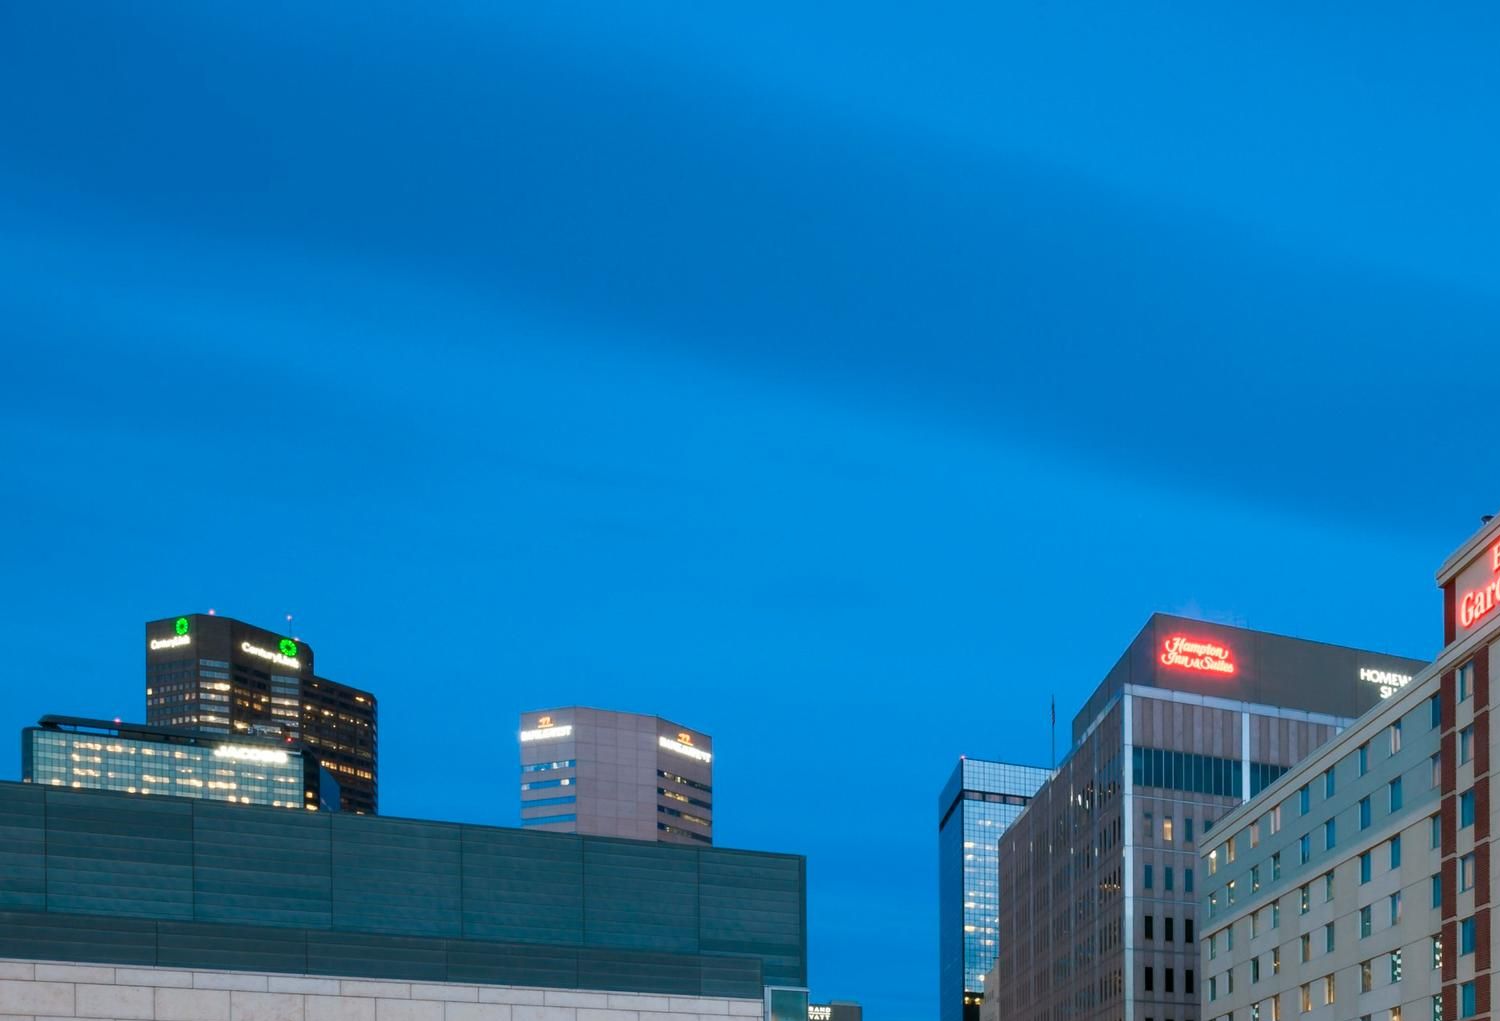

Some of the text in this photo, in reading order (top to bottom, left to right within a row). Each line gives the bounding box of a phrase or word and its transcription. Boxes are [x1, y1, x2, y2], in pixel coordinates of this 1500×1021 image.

[1164, 636, 1230, 660] Hampton
[1161, 651, 1194, 669] Inn
[1201, 656, 1235, 674] Suites
